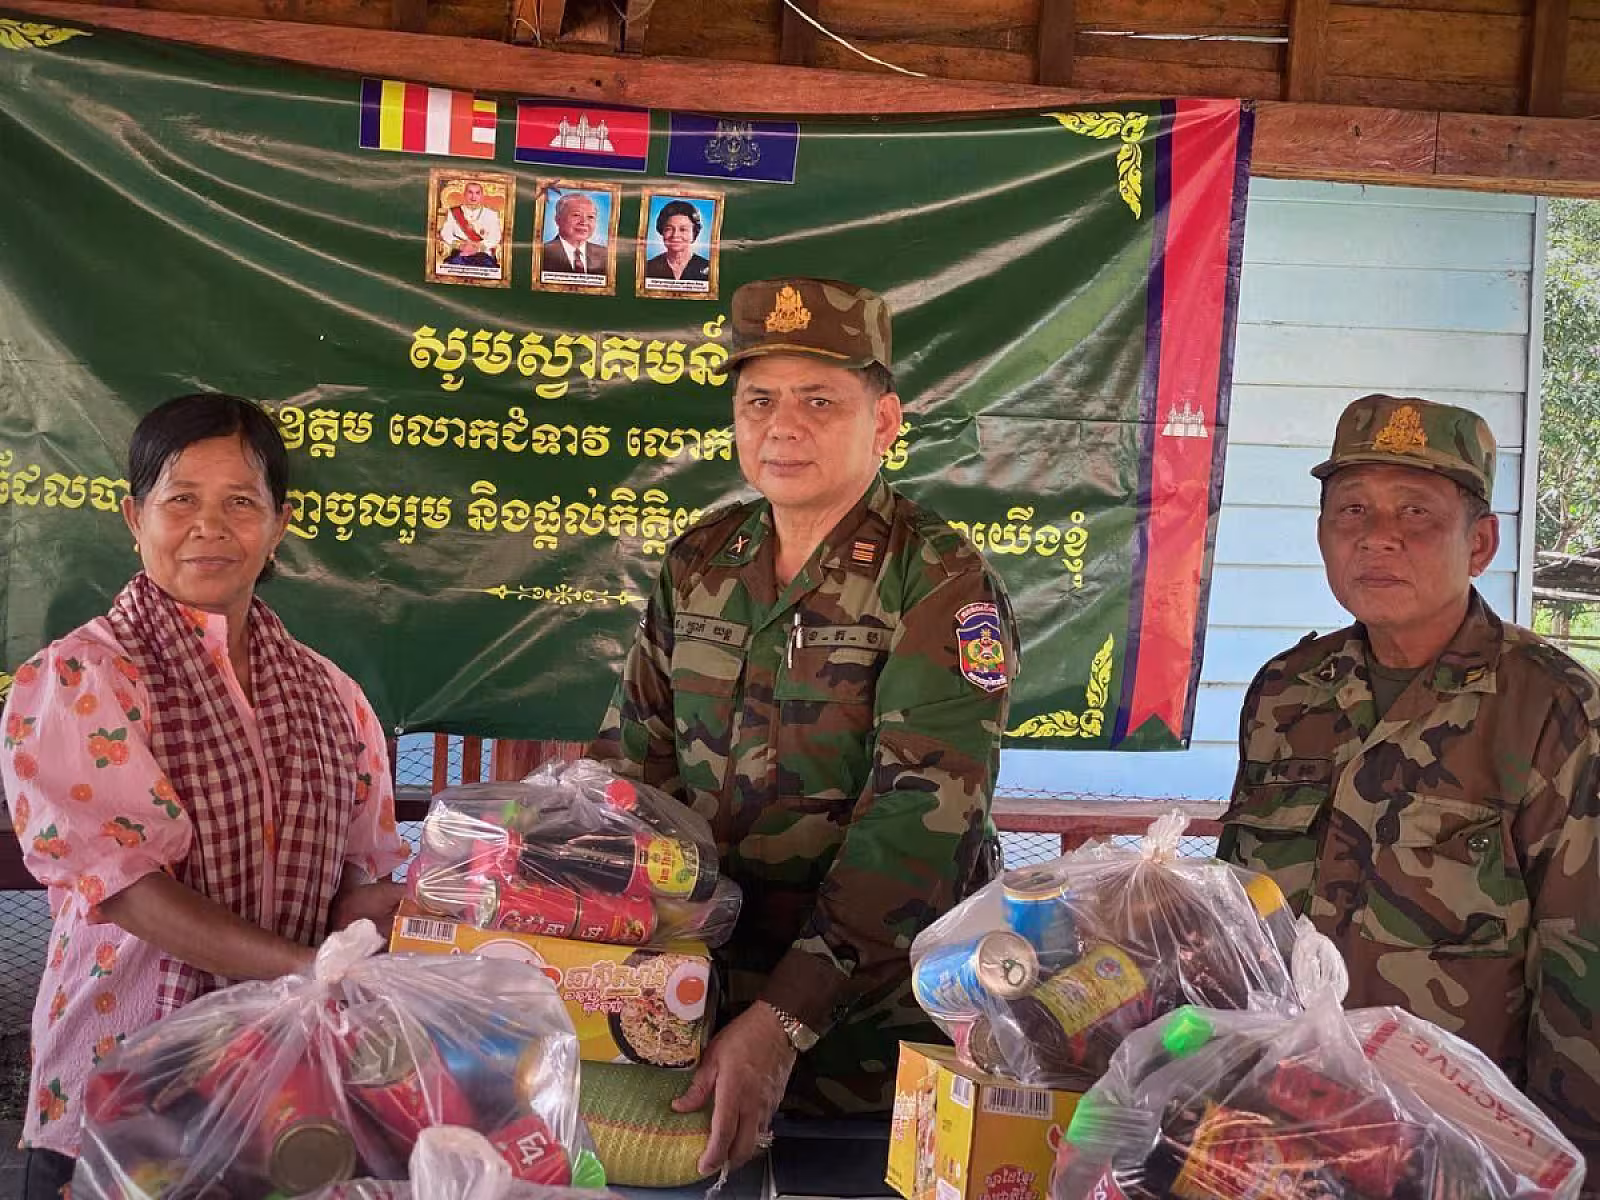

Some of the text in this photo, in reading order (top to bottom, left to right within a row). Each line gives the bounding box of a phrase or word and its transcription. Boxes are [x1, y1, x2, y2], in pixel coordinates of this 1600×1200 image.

[410, 315, 730, 399] សូមស្វាគមន៍
[389, 407, 611, 457] លោកជំទាវ
